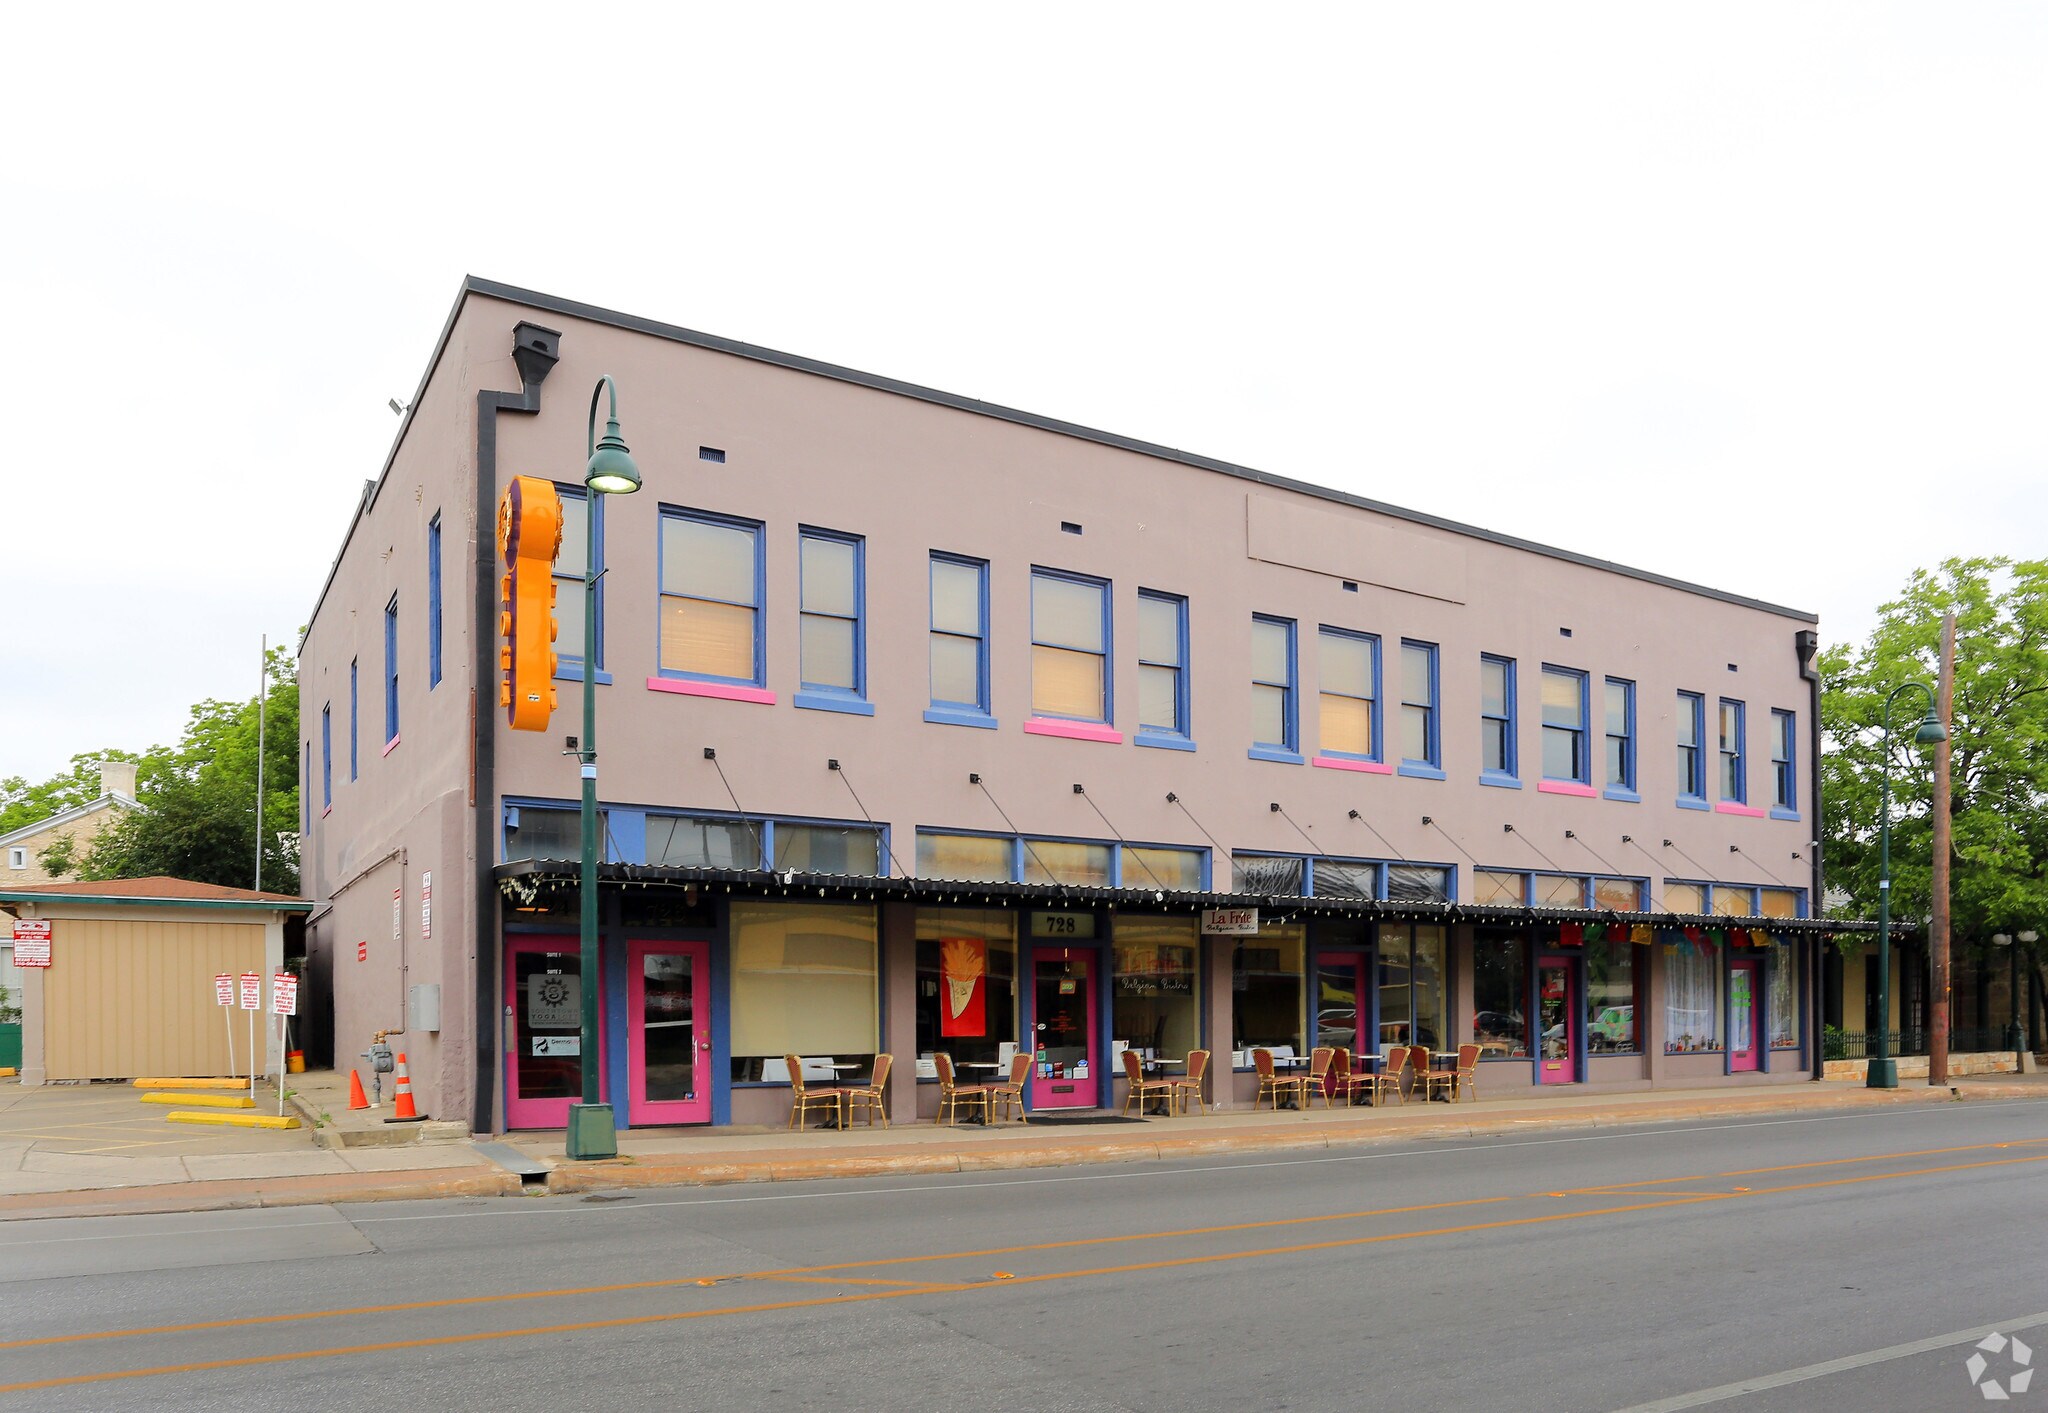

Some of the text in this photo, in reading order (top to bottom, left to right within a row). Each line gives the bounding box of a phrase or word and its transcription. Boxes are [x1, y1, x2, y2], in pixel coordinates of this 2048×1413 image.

[1047, 916, 1075, 933] 728
[1211, 911, 1226, 924] La
[1206, 924, 1235, 932] Belgian
[1122, 977, 1189, 994] Belgian Bistro
